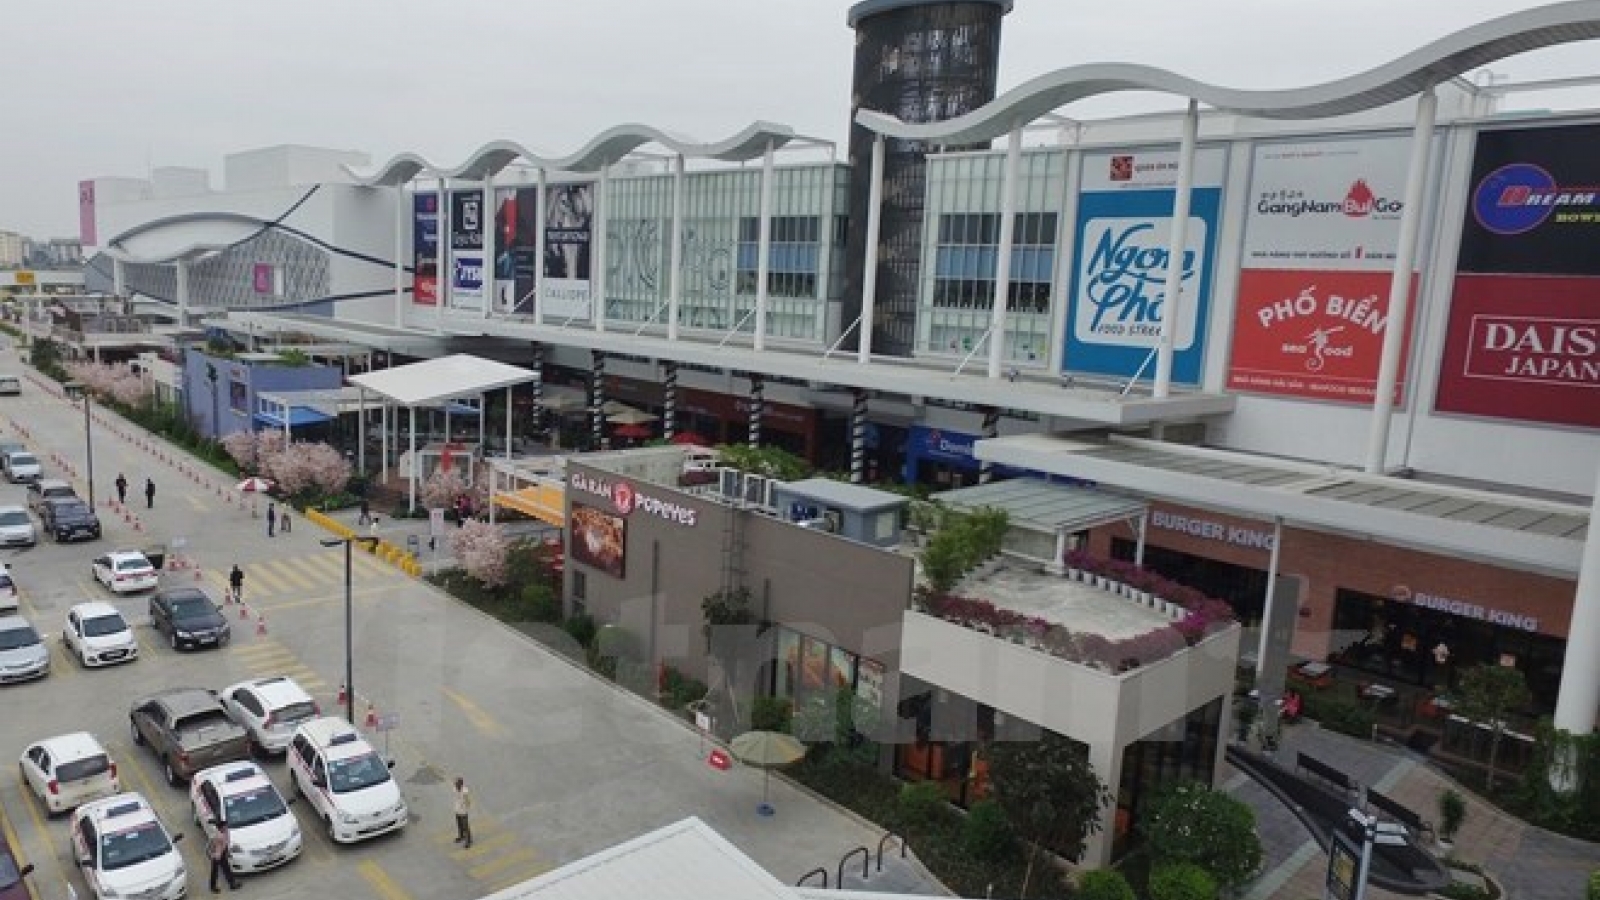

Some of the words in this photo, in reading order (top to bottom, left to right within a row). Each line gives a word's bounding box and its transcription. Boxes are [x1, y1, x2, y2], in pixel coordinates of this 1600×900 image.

[1258, 285, 1318, 328] PHỐ
[1504, 356, 1600, 380] JAPAN
[1152, 510, 1224, 541] BURGER
[1227, 524, 1276, 551] KING
[1415, 592, 1485, 621] BURGER
[1487, 608, 1538, 633] KING
